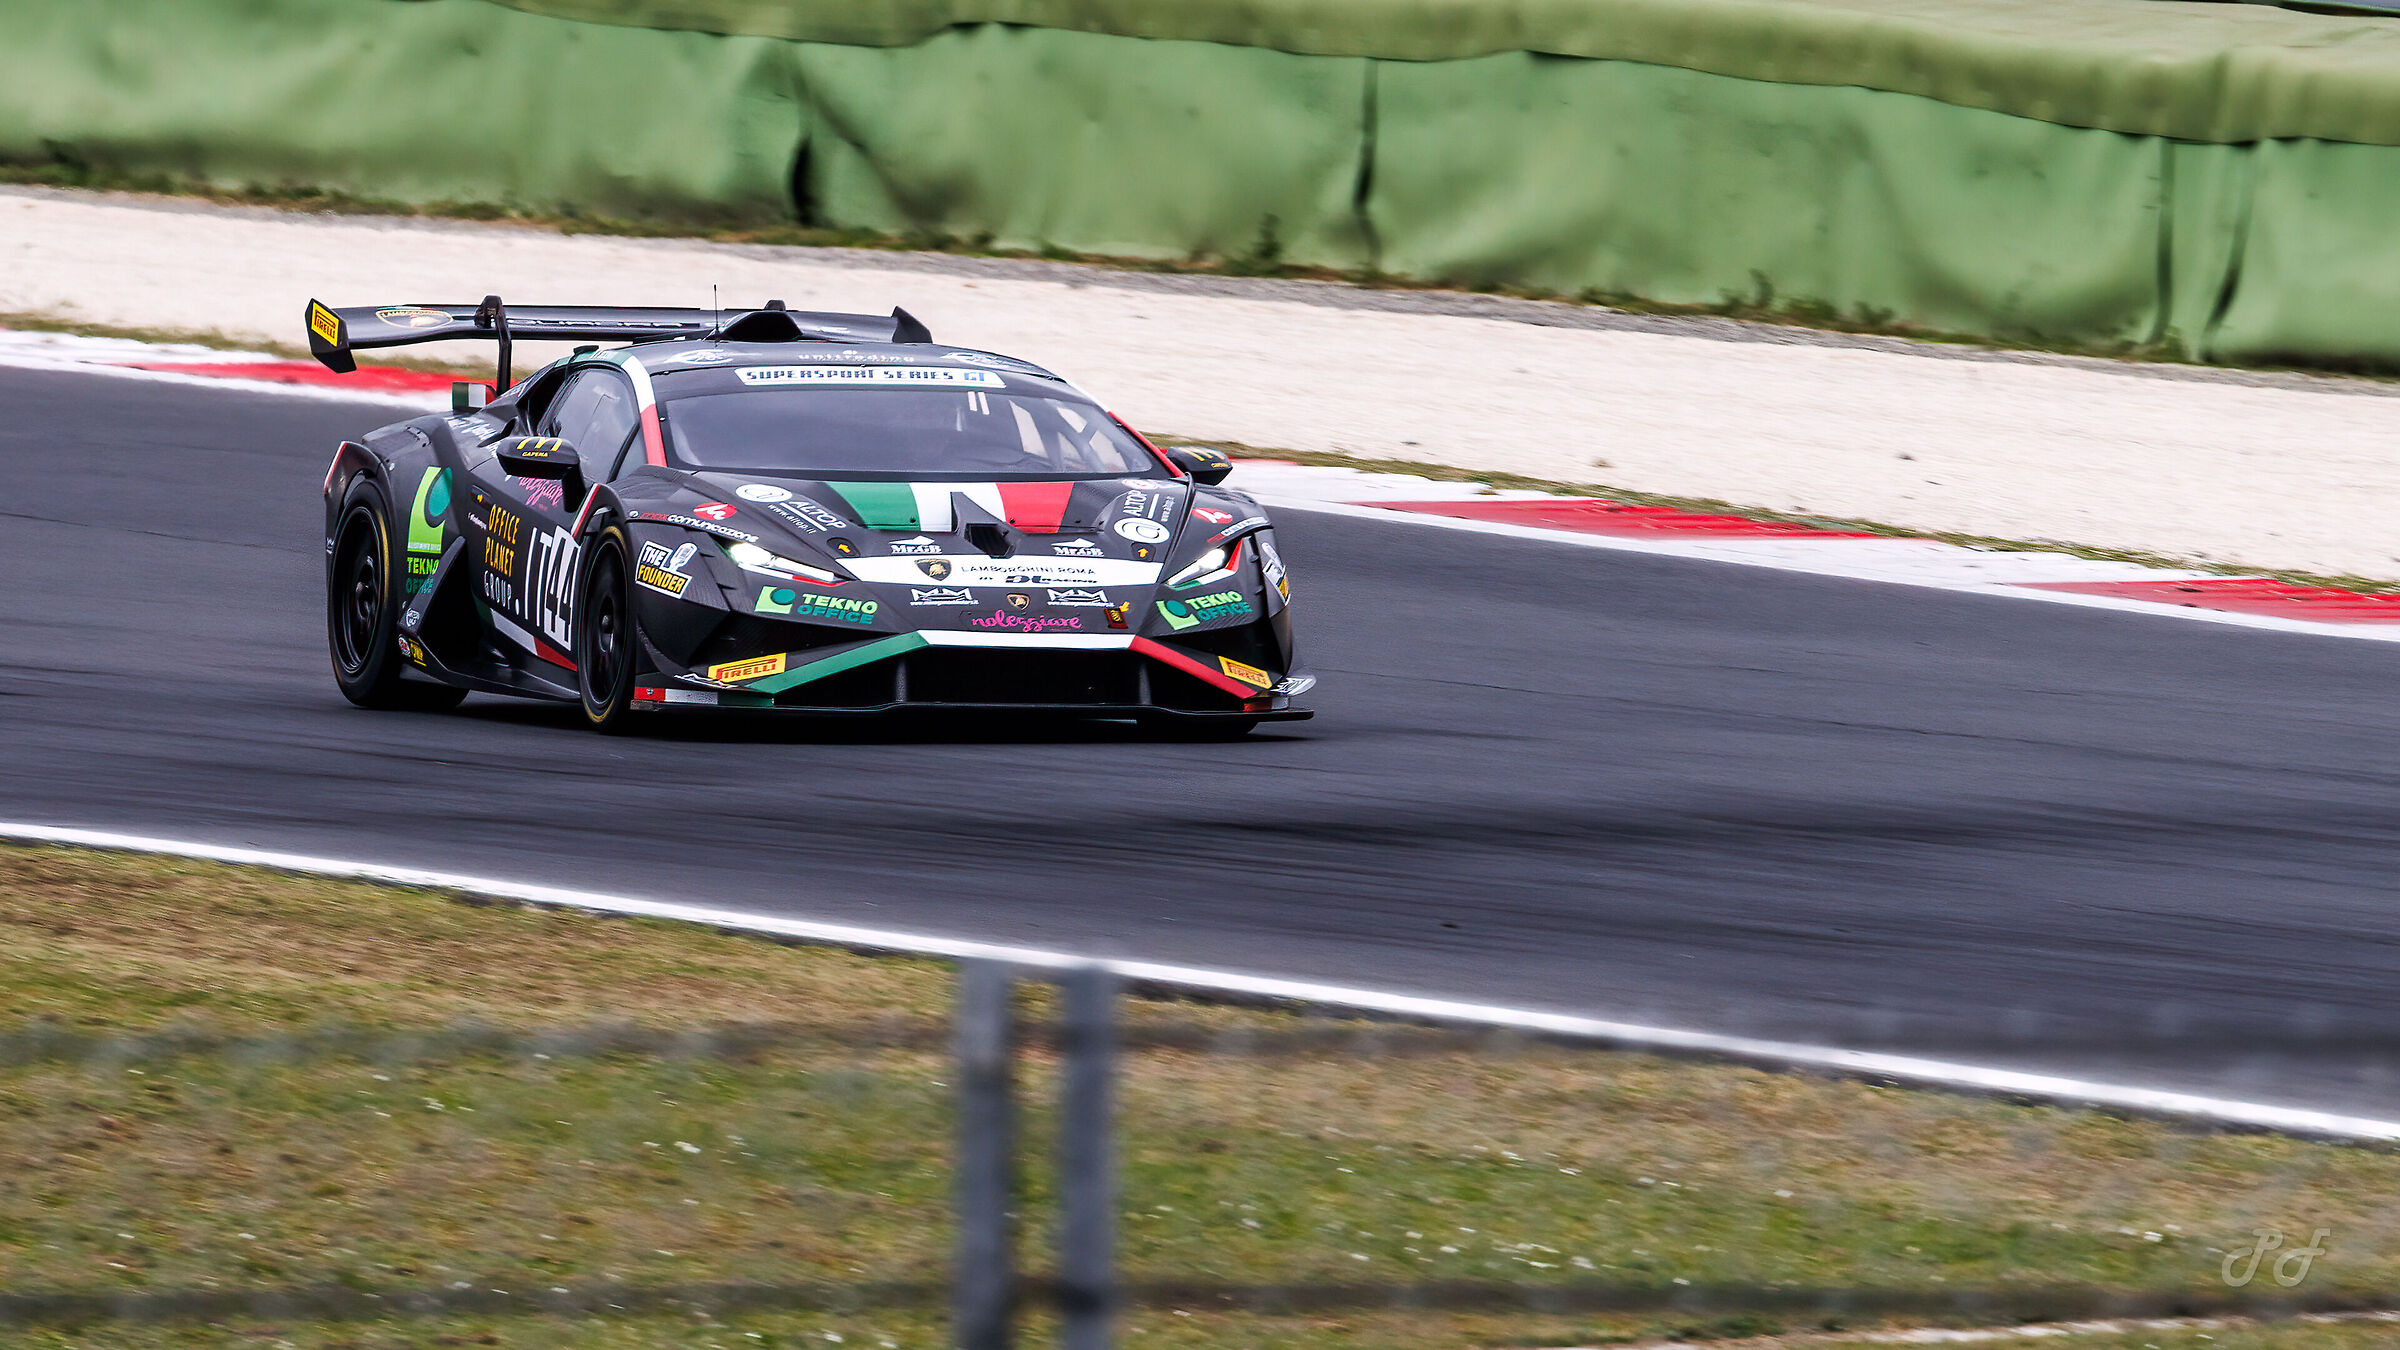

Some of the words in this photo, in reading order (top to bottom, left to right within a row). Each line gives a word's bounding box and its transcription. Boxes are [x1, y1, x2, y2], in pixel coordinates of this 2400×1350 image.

[315, 309, 336, 339] PIRELLI
[747, 369, 873, 380] SUPERSPORT
[884, 370, 953, 380] SERIES
[1123, 489, 1148, 517] ALTOP
[489, 504, 520, 544] OFFICE
[788, 501, 846, 528] ALTOP
[407, 557, 440, 575] TEKNO
[485, 536, 515, 577] PLANET
[642, 545, 667, 566] THE
[637, 564, 686, 593] FOUNDER
[802, 593, 878, 614] TEKNO
[1185, 590, 1243, 610] TEKNO
[797, 604, 874, 624] OFFICE
[1198, 602, 1253, 621] OFFICE
[716, 659, 777, 680] PIRELLI
